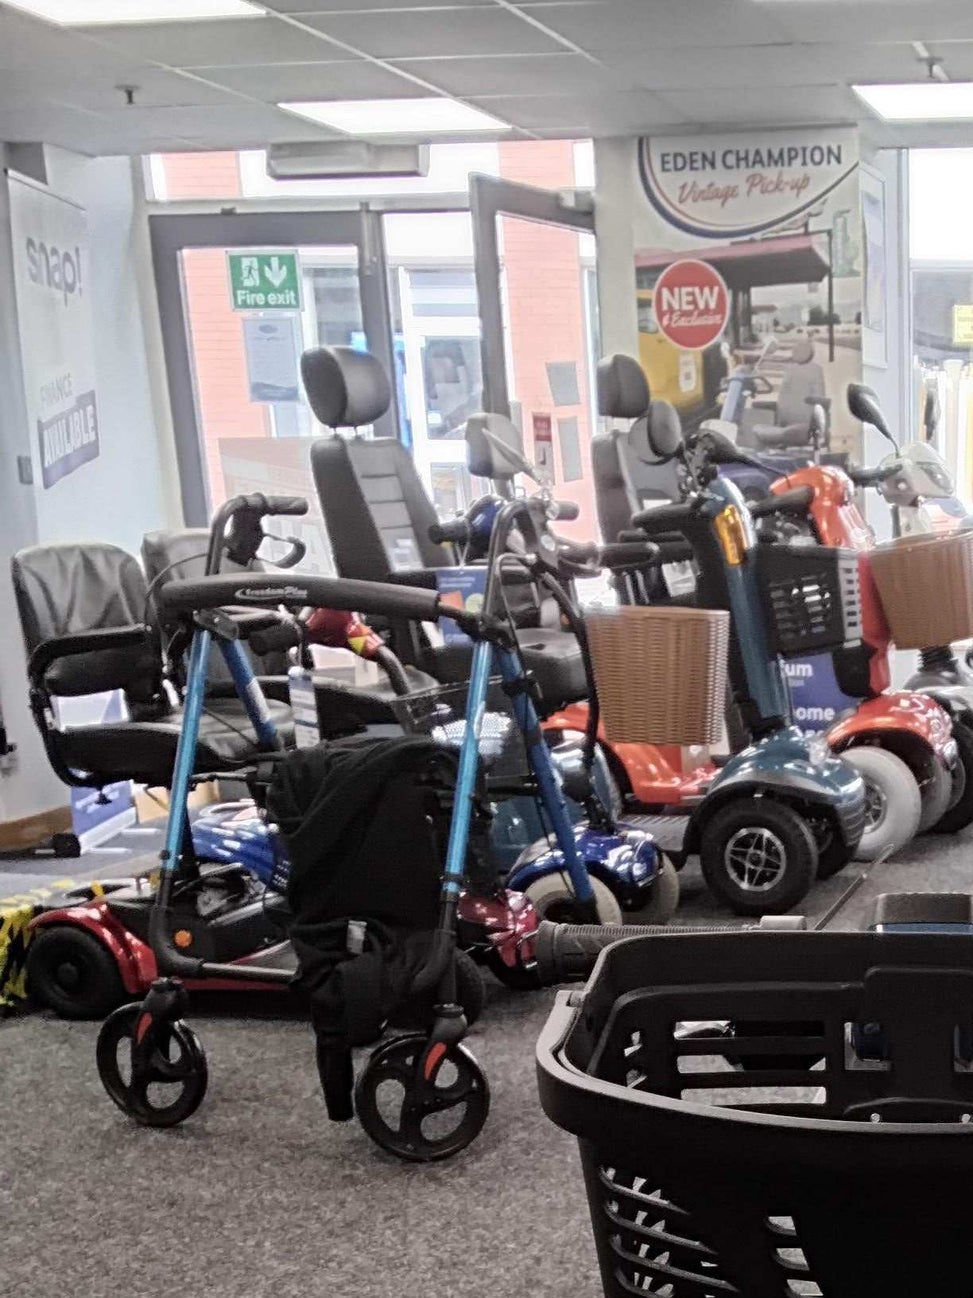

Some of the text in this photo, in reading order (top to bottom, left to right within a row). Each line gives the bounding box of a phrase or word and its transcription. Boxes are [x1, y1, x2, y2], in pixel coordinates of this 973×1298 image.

[661, 145, 842, 172] EDEN CHAMPION
[678, 171, 811, 208] Vintage Pick-up
[26, 237, 82, 307] snap!
[236, 290, 296, 305] Fire exit
[661, 286, 719, 311] NEW
[794, 707, 836, 721] ome
